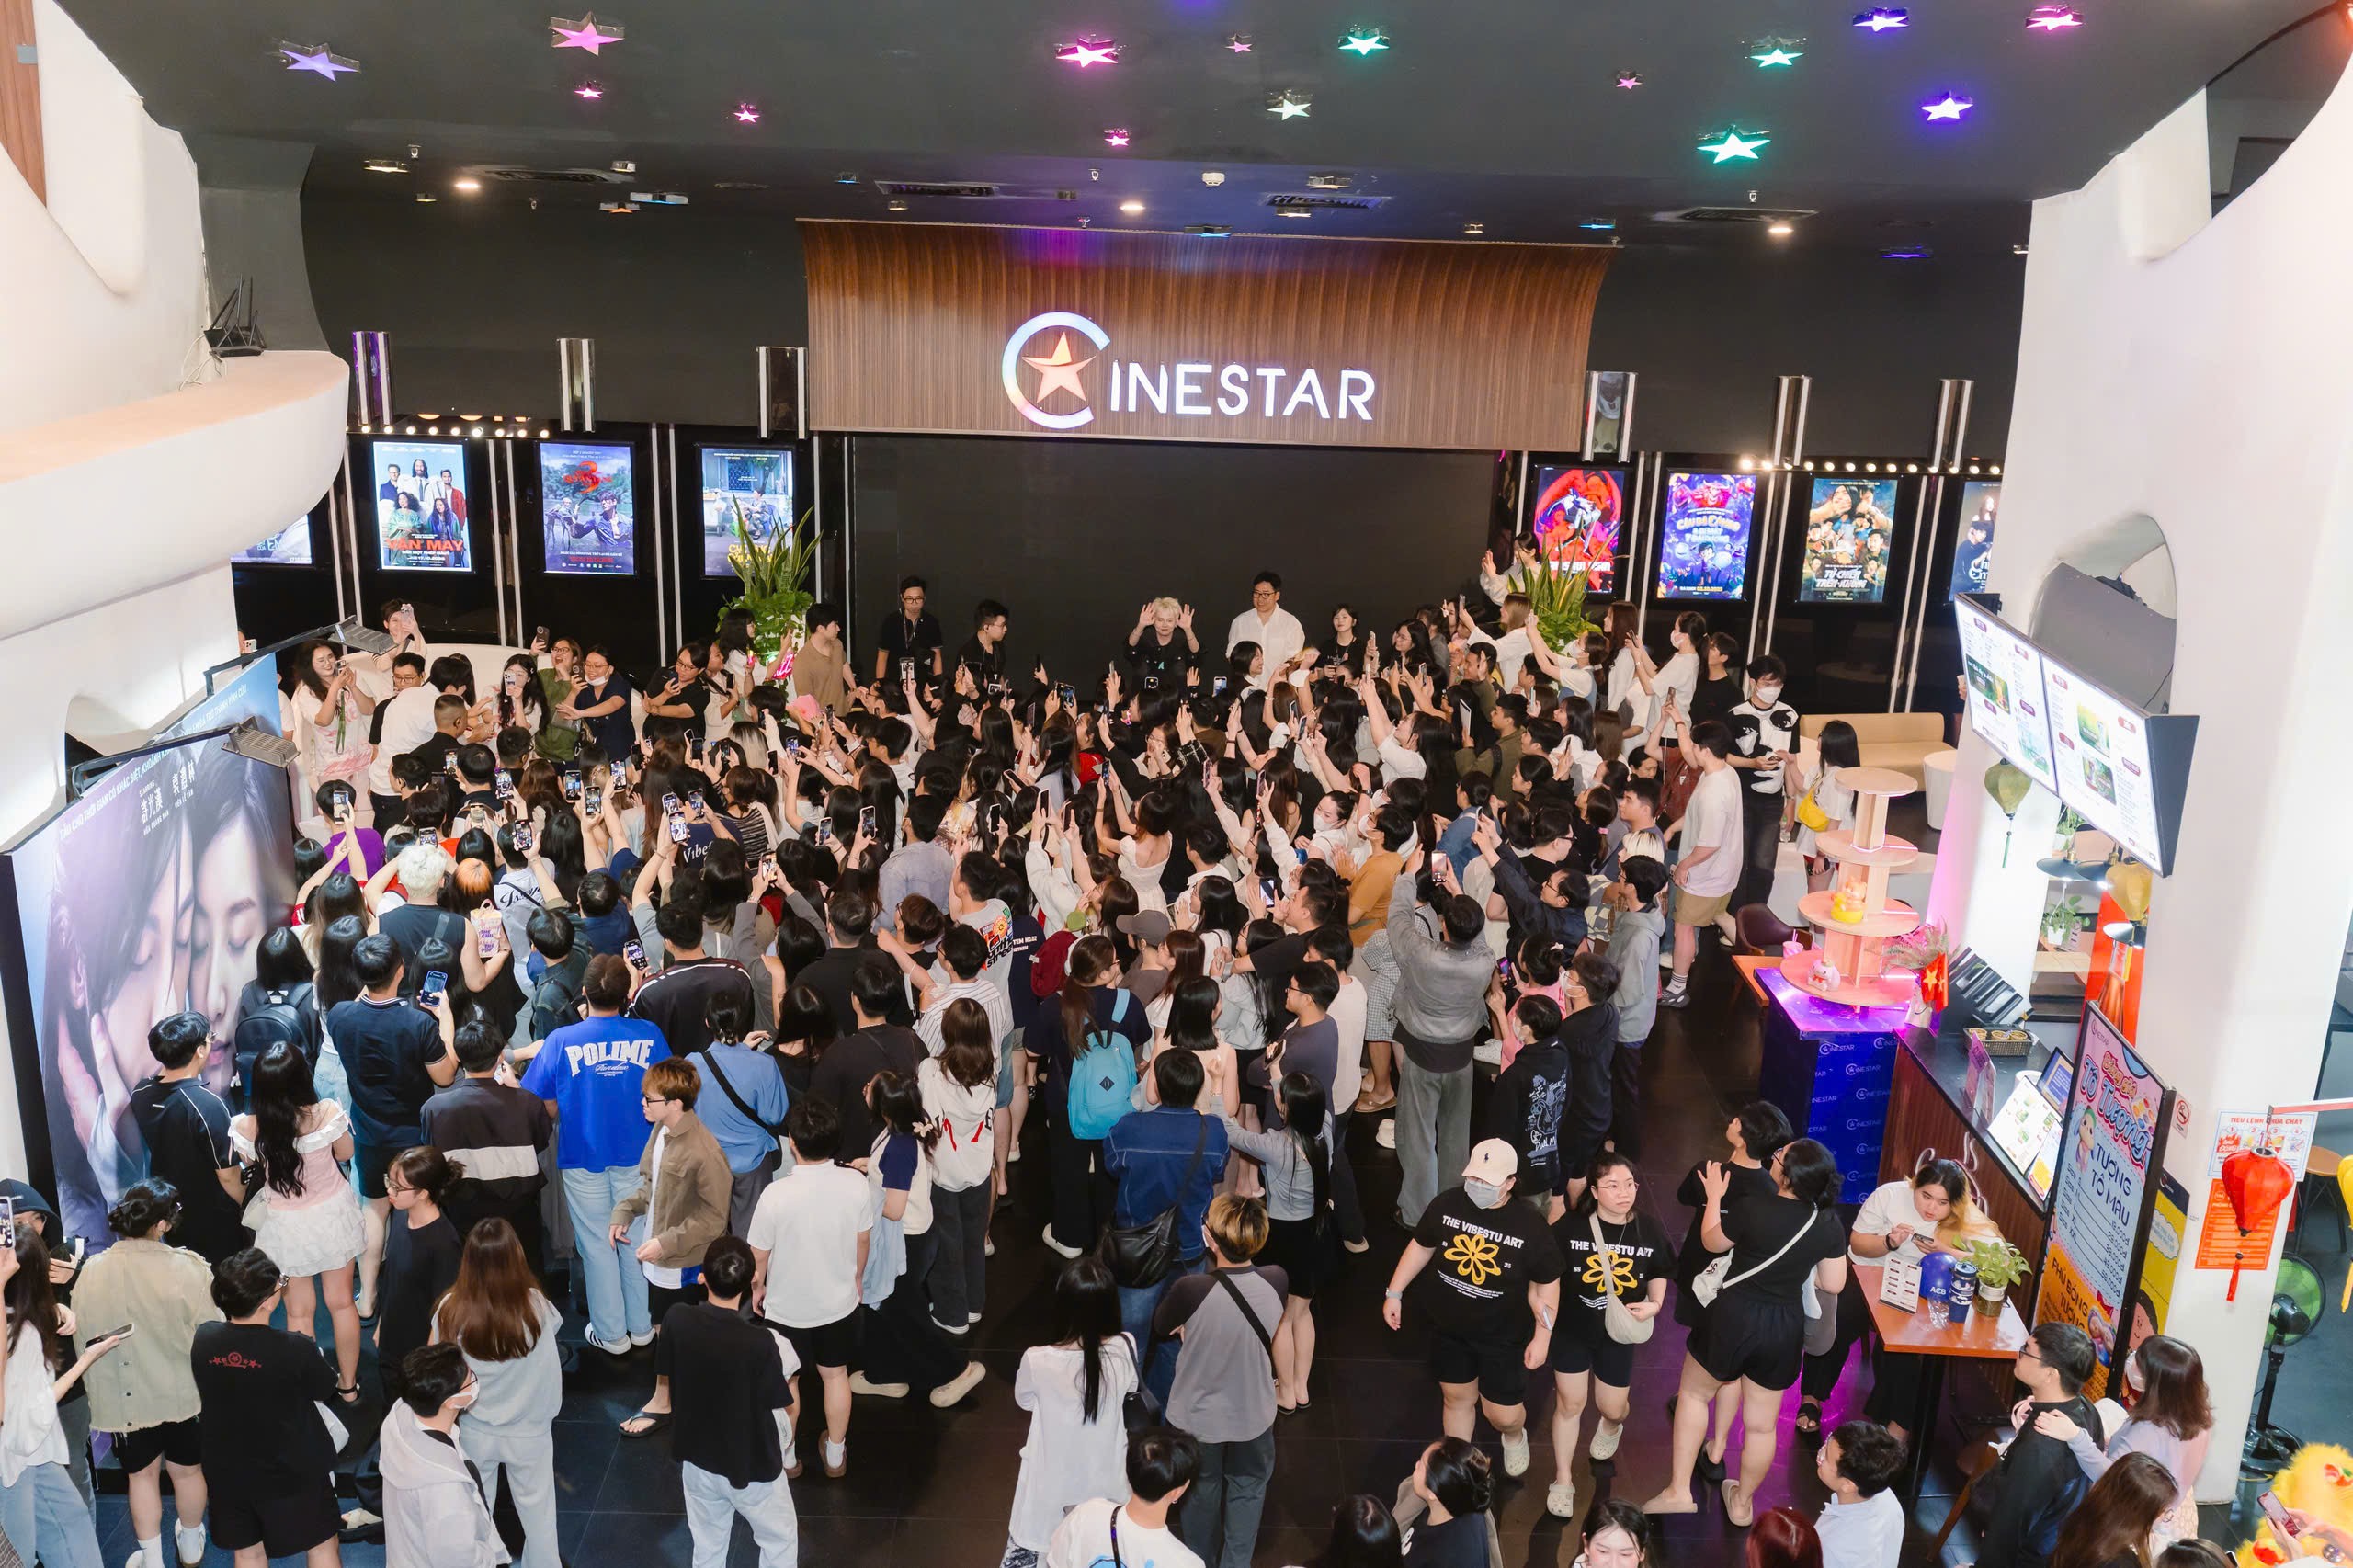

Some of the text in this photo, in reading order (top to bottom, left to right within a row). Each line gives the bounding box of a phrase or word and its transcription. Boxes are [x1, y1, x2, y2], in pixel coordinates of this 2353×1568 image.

[1002, 311, 1376, 430] CINESTAR
[683, 841, 713, 863] Vibe
[1820, 1043, 1855, 1055] CINESTAR
[1811, 1095, 1837, 1104] INESTAR
[2081, 1057, 2150, 1164] Tô Tượng
[2097, 1142, 2131, 1196] TƯỢNG
[2090, 1168, 2131, 1227] TÔ MÀU
[1442, 1214, 1524, 1249] THE VIBESTU ART
[1570, 1239, 1589, 1251] THE
[1929, 1286, 1947, 1295] ACB
